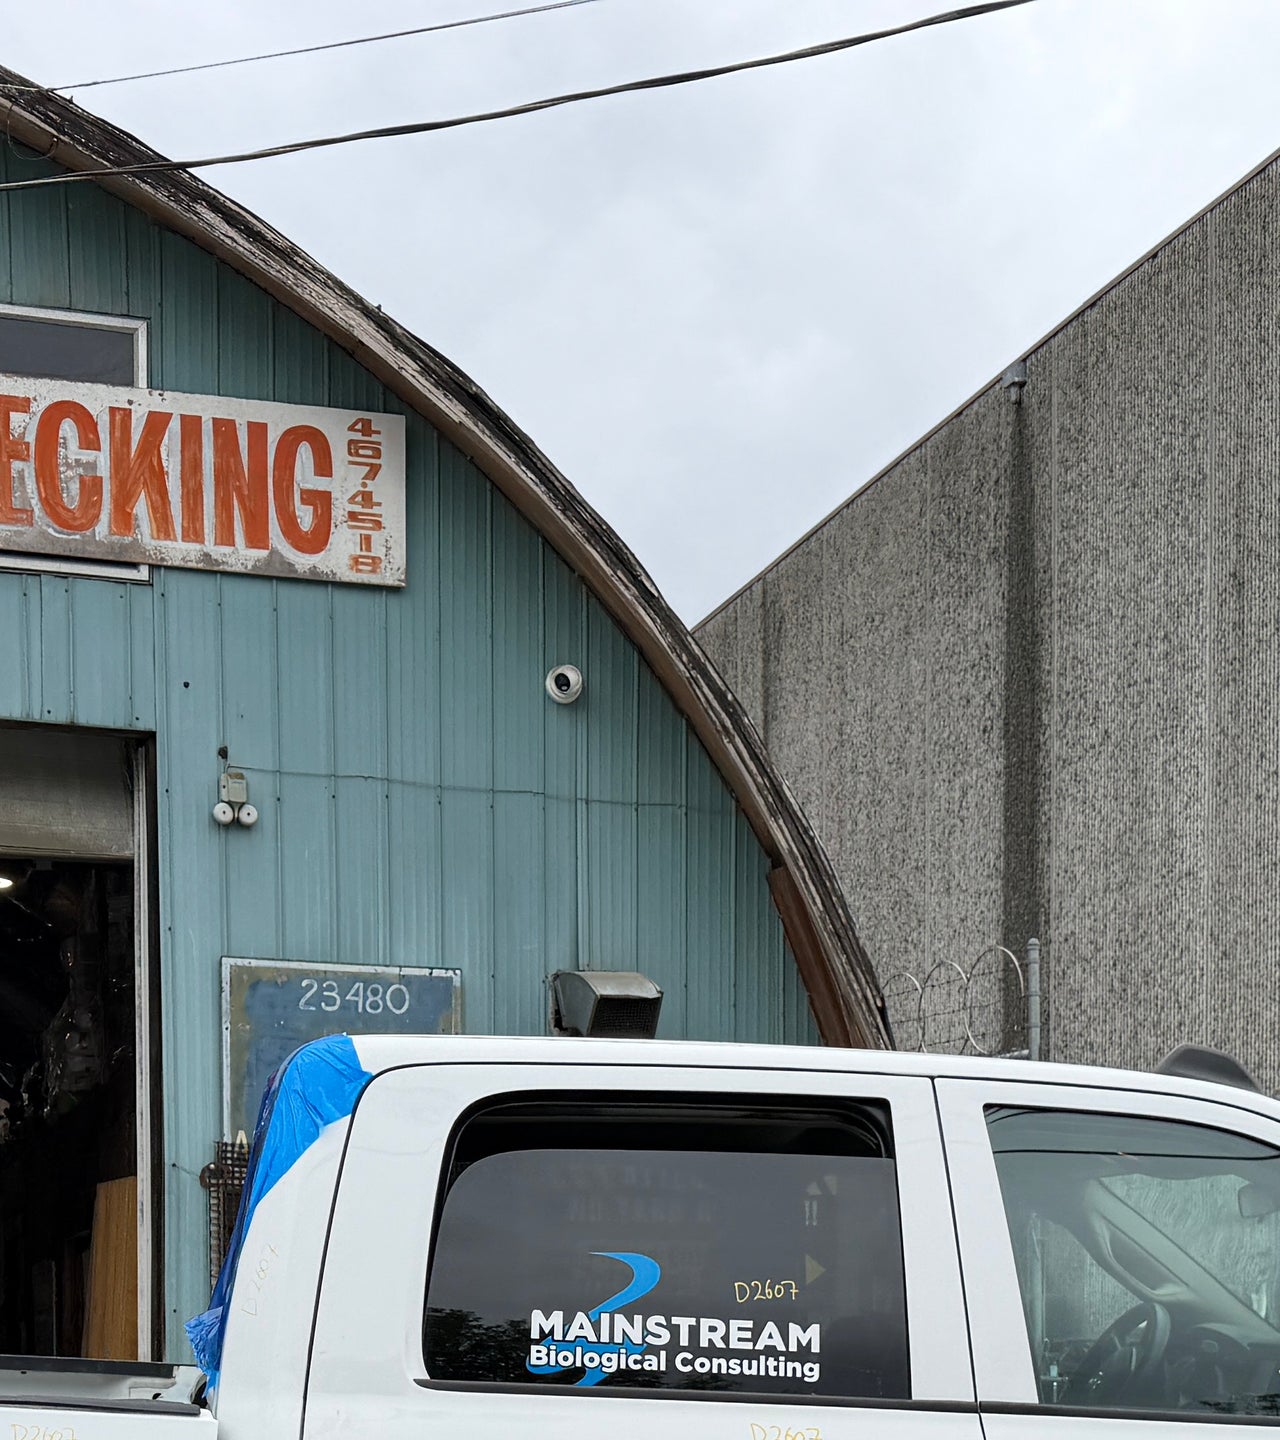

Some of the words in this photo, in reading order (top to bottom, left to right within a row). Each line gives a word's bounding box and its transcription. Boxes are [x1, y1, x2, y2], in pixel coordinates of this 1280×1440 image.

[299, 979, 409, 1014] 23480
[734, 1280, 799, 1303] D2607
[530, 1309, 820, 1353] MAINSTREAM
[529, 1345, 666, 1373] Biological
[674, 1352, 820, 1383] Consulting
